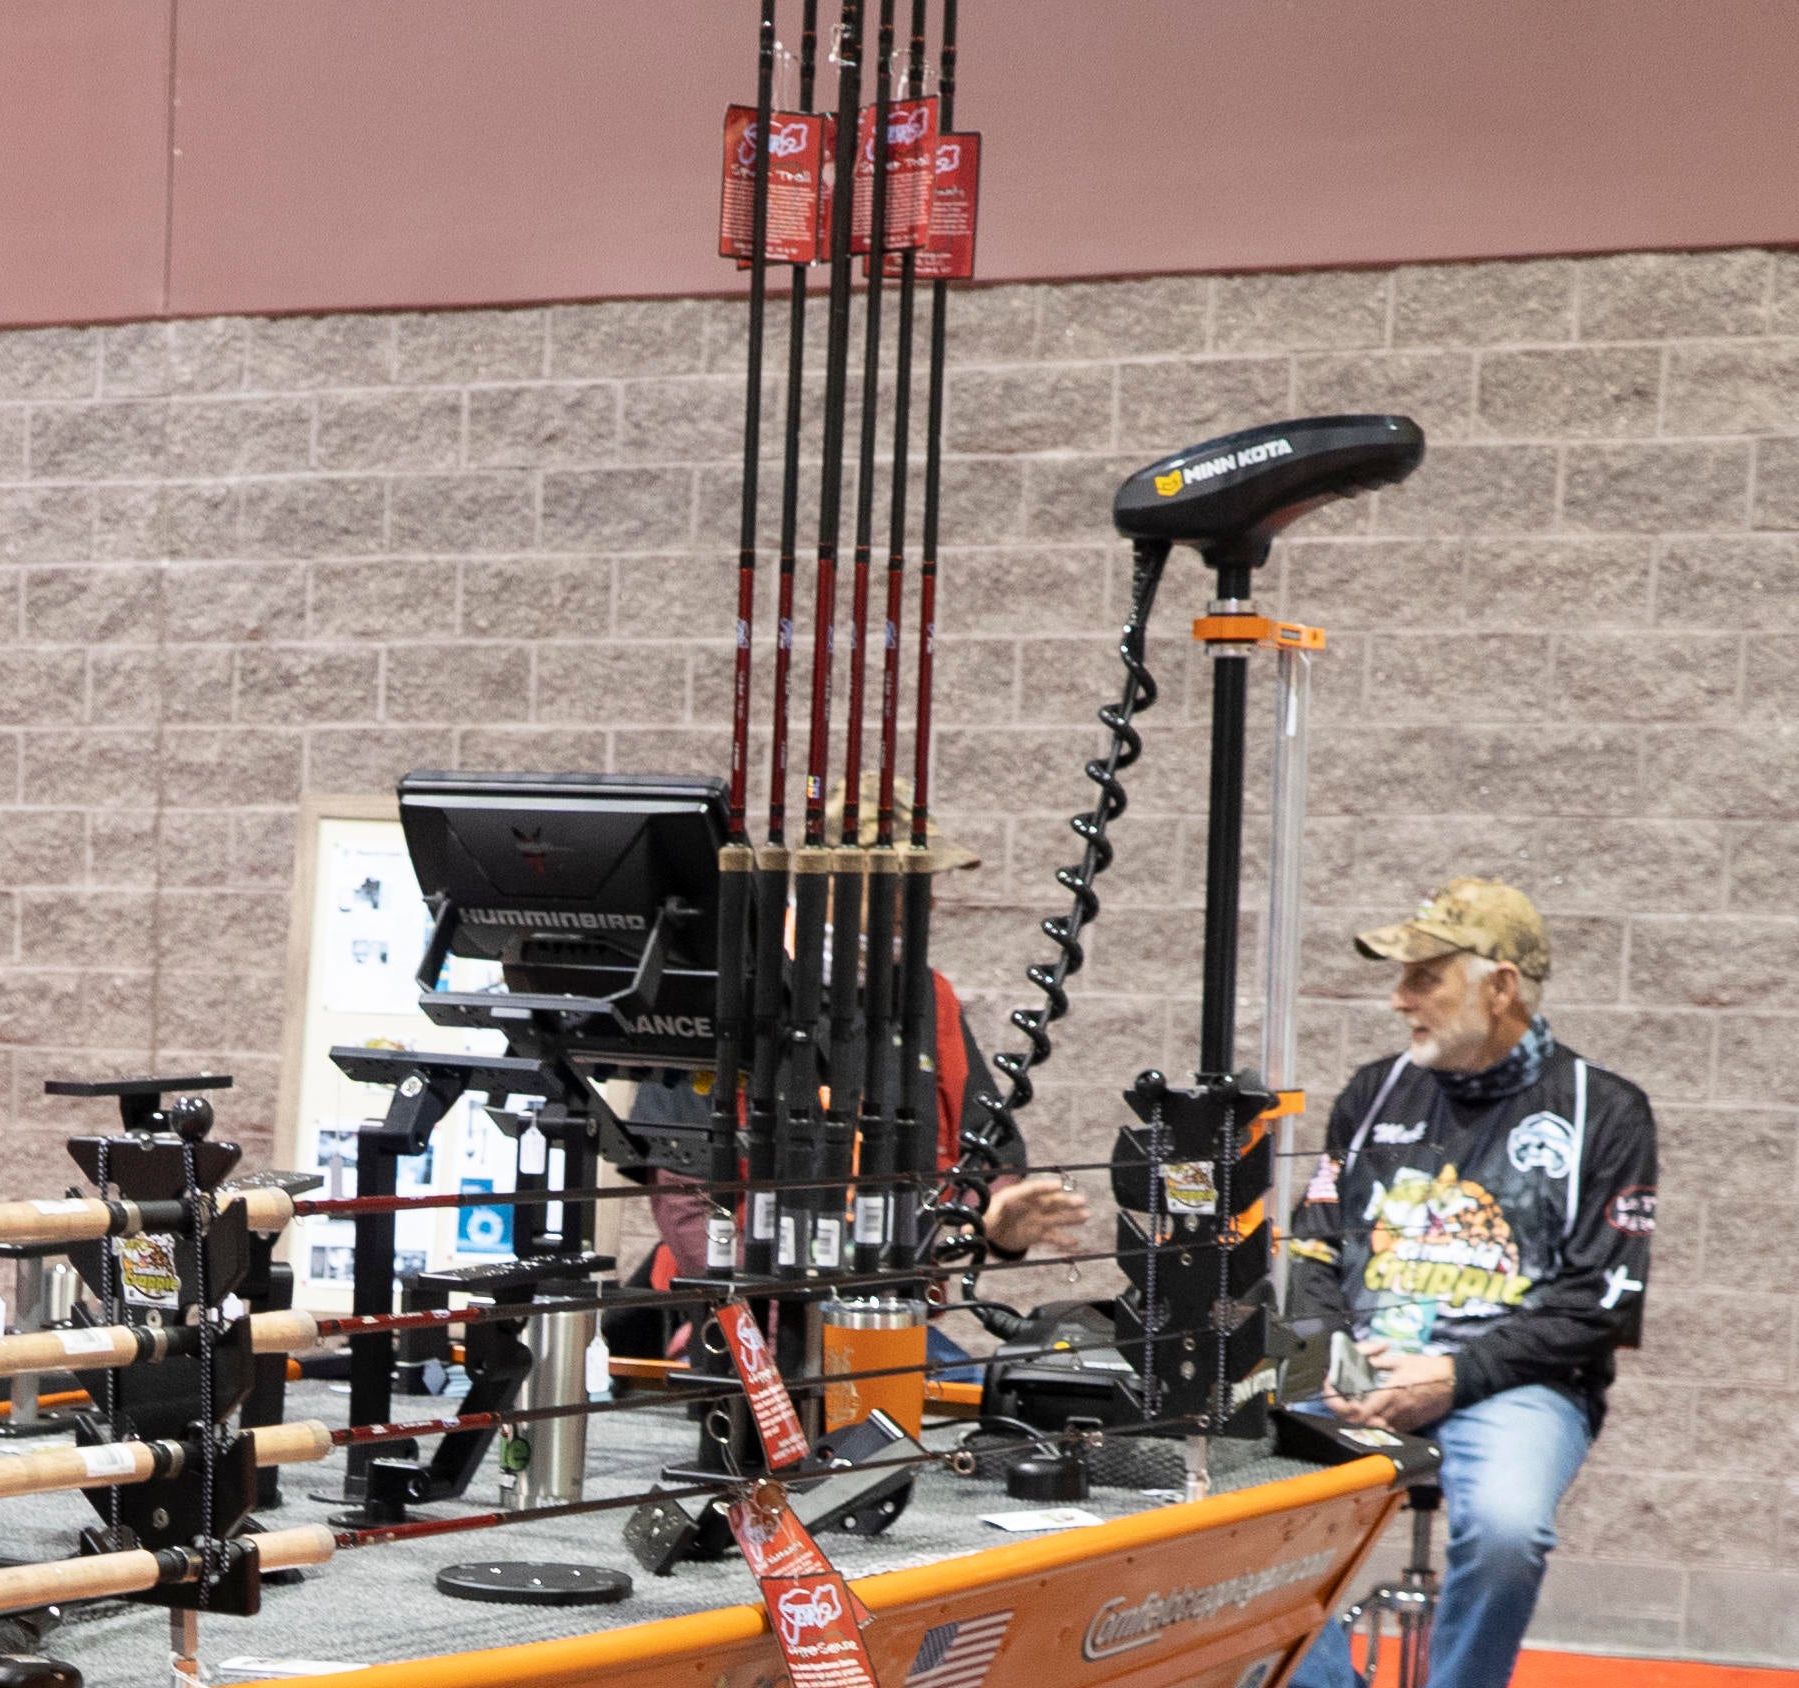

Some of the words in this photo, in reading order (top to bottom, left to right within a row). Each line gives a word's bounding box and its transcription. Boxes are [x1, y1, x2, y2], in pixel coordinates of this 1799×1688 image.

[1183, 455, 1235, 486] MINN
[1237, 438, 1293, 469] KOTA
[457, 906, 646, 931] HUMMINBIRD
[635, 1014, 715, 1038] ANCE
